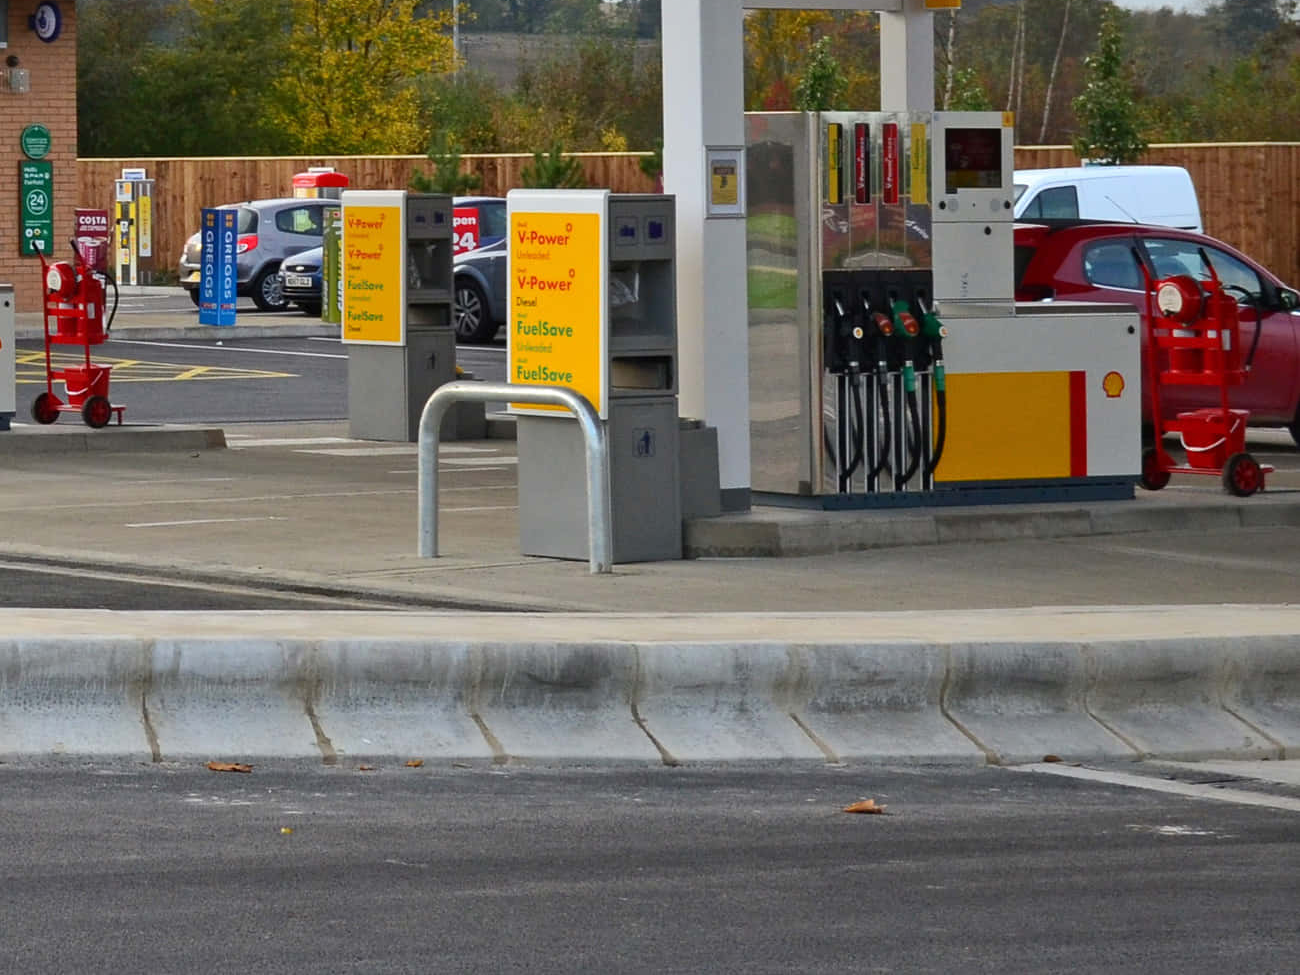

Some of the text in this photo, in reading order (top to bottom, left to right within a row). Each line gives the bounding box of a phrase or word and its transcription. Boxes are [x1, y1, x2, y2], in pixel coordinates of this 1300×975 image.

[30, 194, 45, 206] 24
[79, 216, 107, 225] COSTA
[348, 217, 383, 229] V-Power
[453, 217, 476, 227] pen
[518, 230, 570, 246] V-Power
[348, 249, 381, 260] V-Power
[205, 230, 214, 298] GREGGS
[224, 231, 233, 299] GREGGS
[348, 280, 384, 290] FuelSave
[517, 275, 572, 291] V-Power
[516, 297, 538, 307] Diesel
[348, 310, 384, 321] FuelSave
[517, 320, 573, 337] FuelSave
[517, 365, 573, 383] FuelSave
